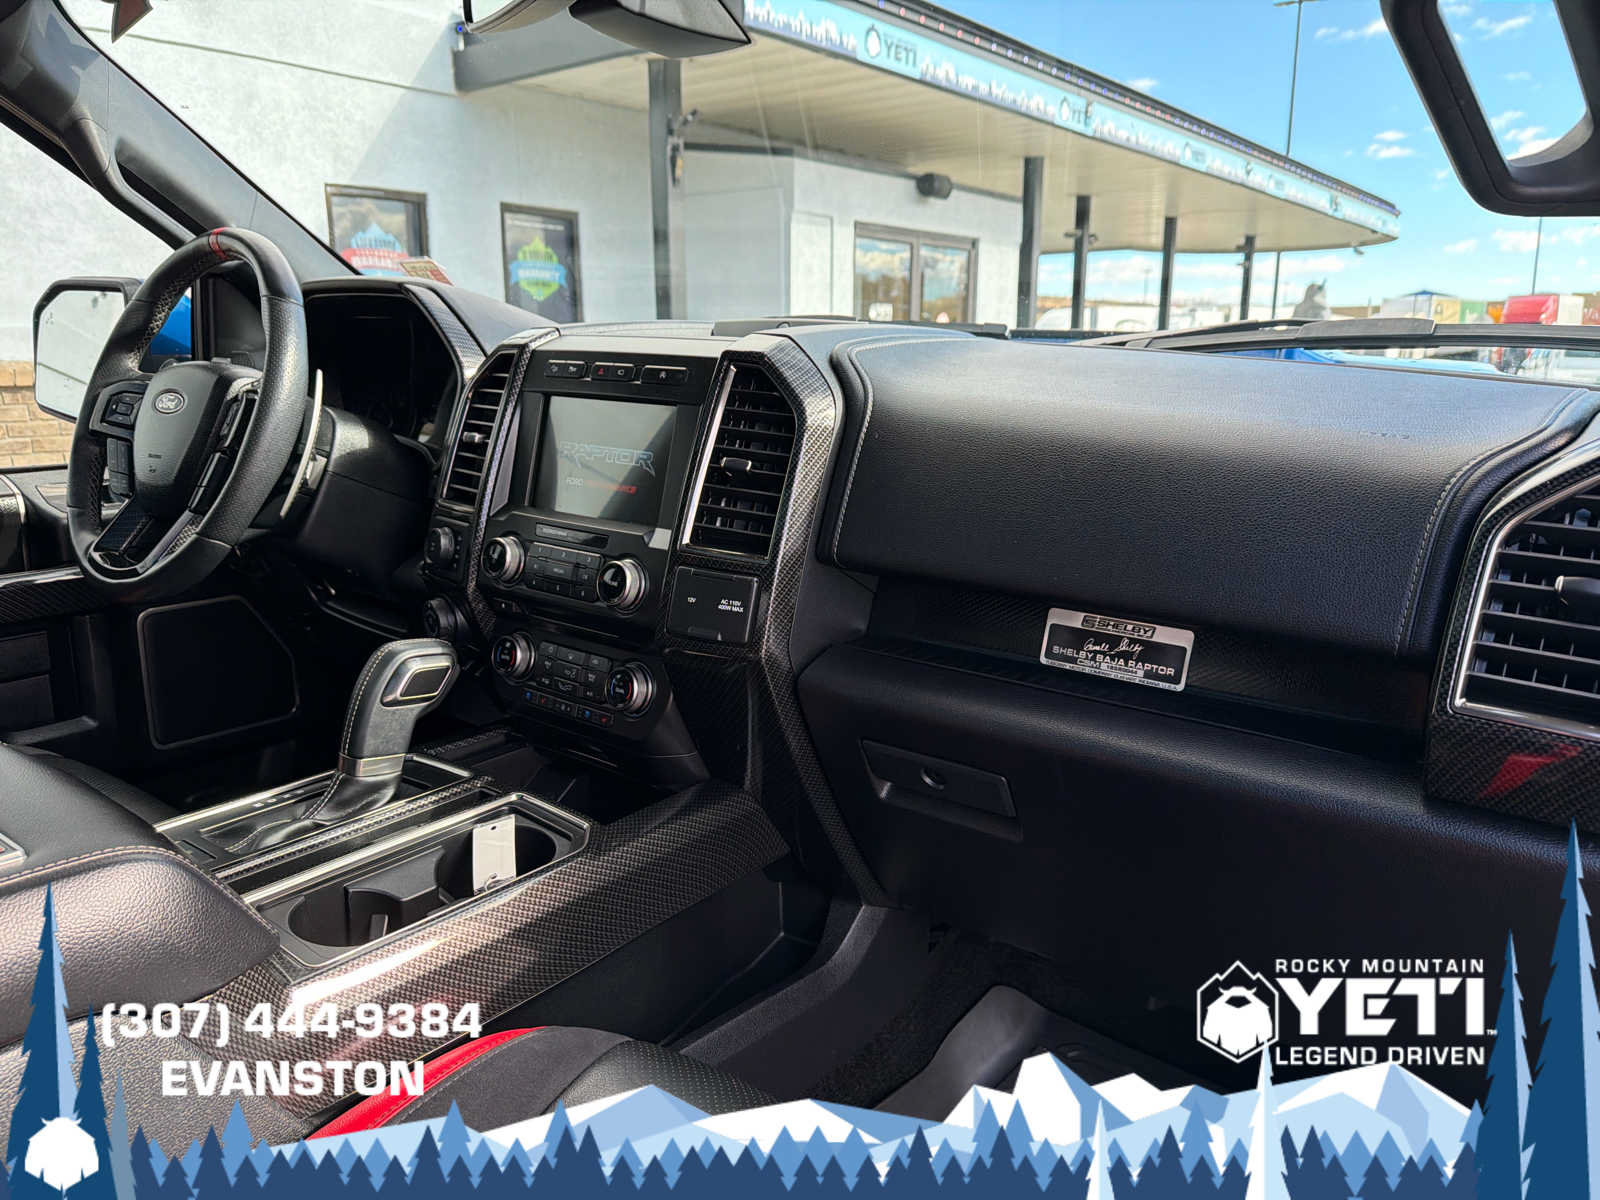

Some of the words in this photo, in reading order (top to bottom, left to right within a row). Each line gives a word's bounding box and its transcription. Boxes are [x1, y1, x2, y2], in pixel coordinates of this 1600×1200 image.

[884, 39, 917, 67] YETI
[559, 441, 655, 477] RAPTOR
[1096, 619, 1152, 635] SHELBY
[1052, 646, 1094, 661] SHELBY
[1096, 655, 1125, 667] BAJA
[1128, 660, 1175, 677] RAPTOR
